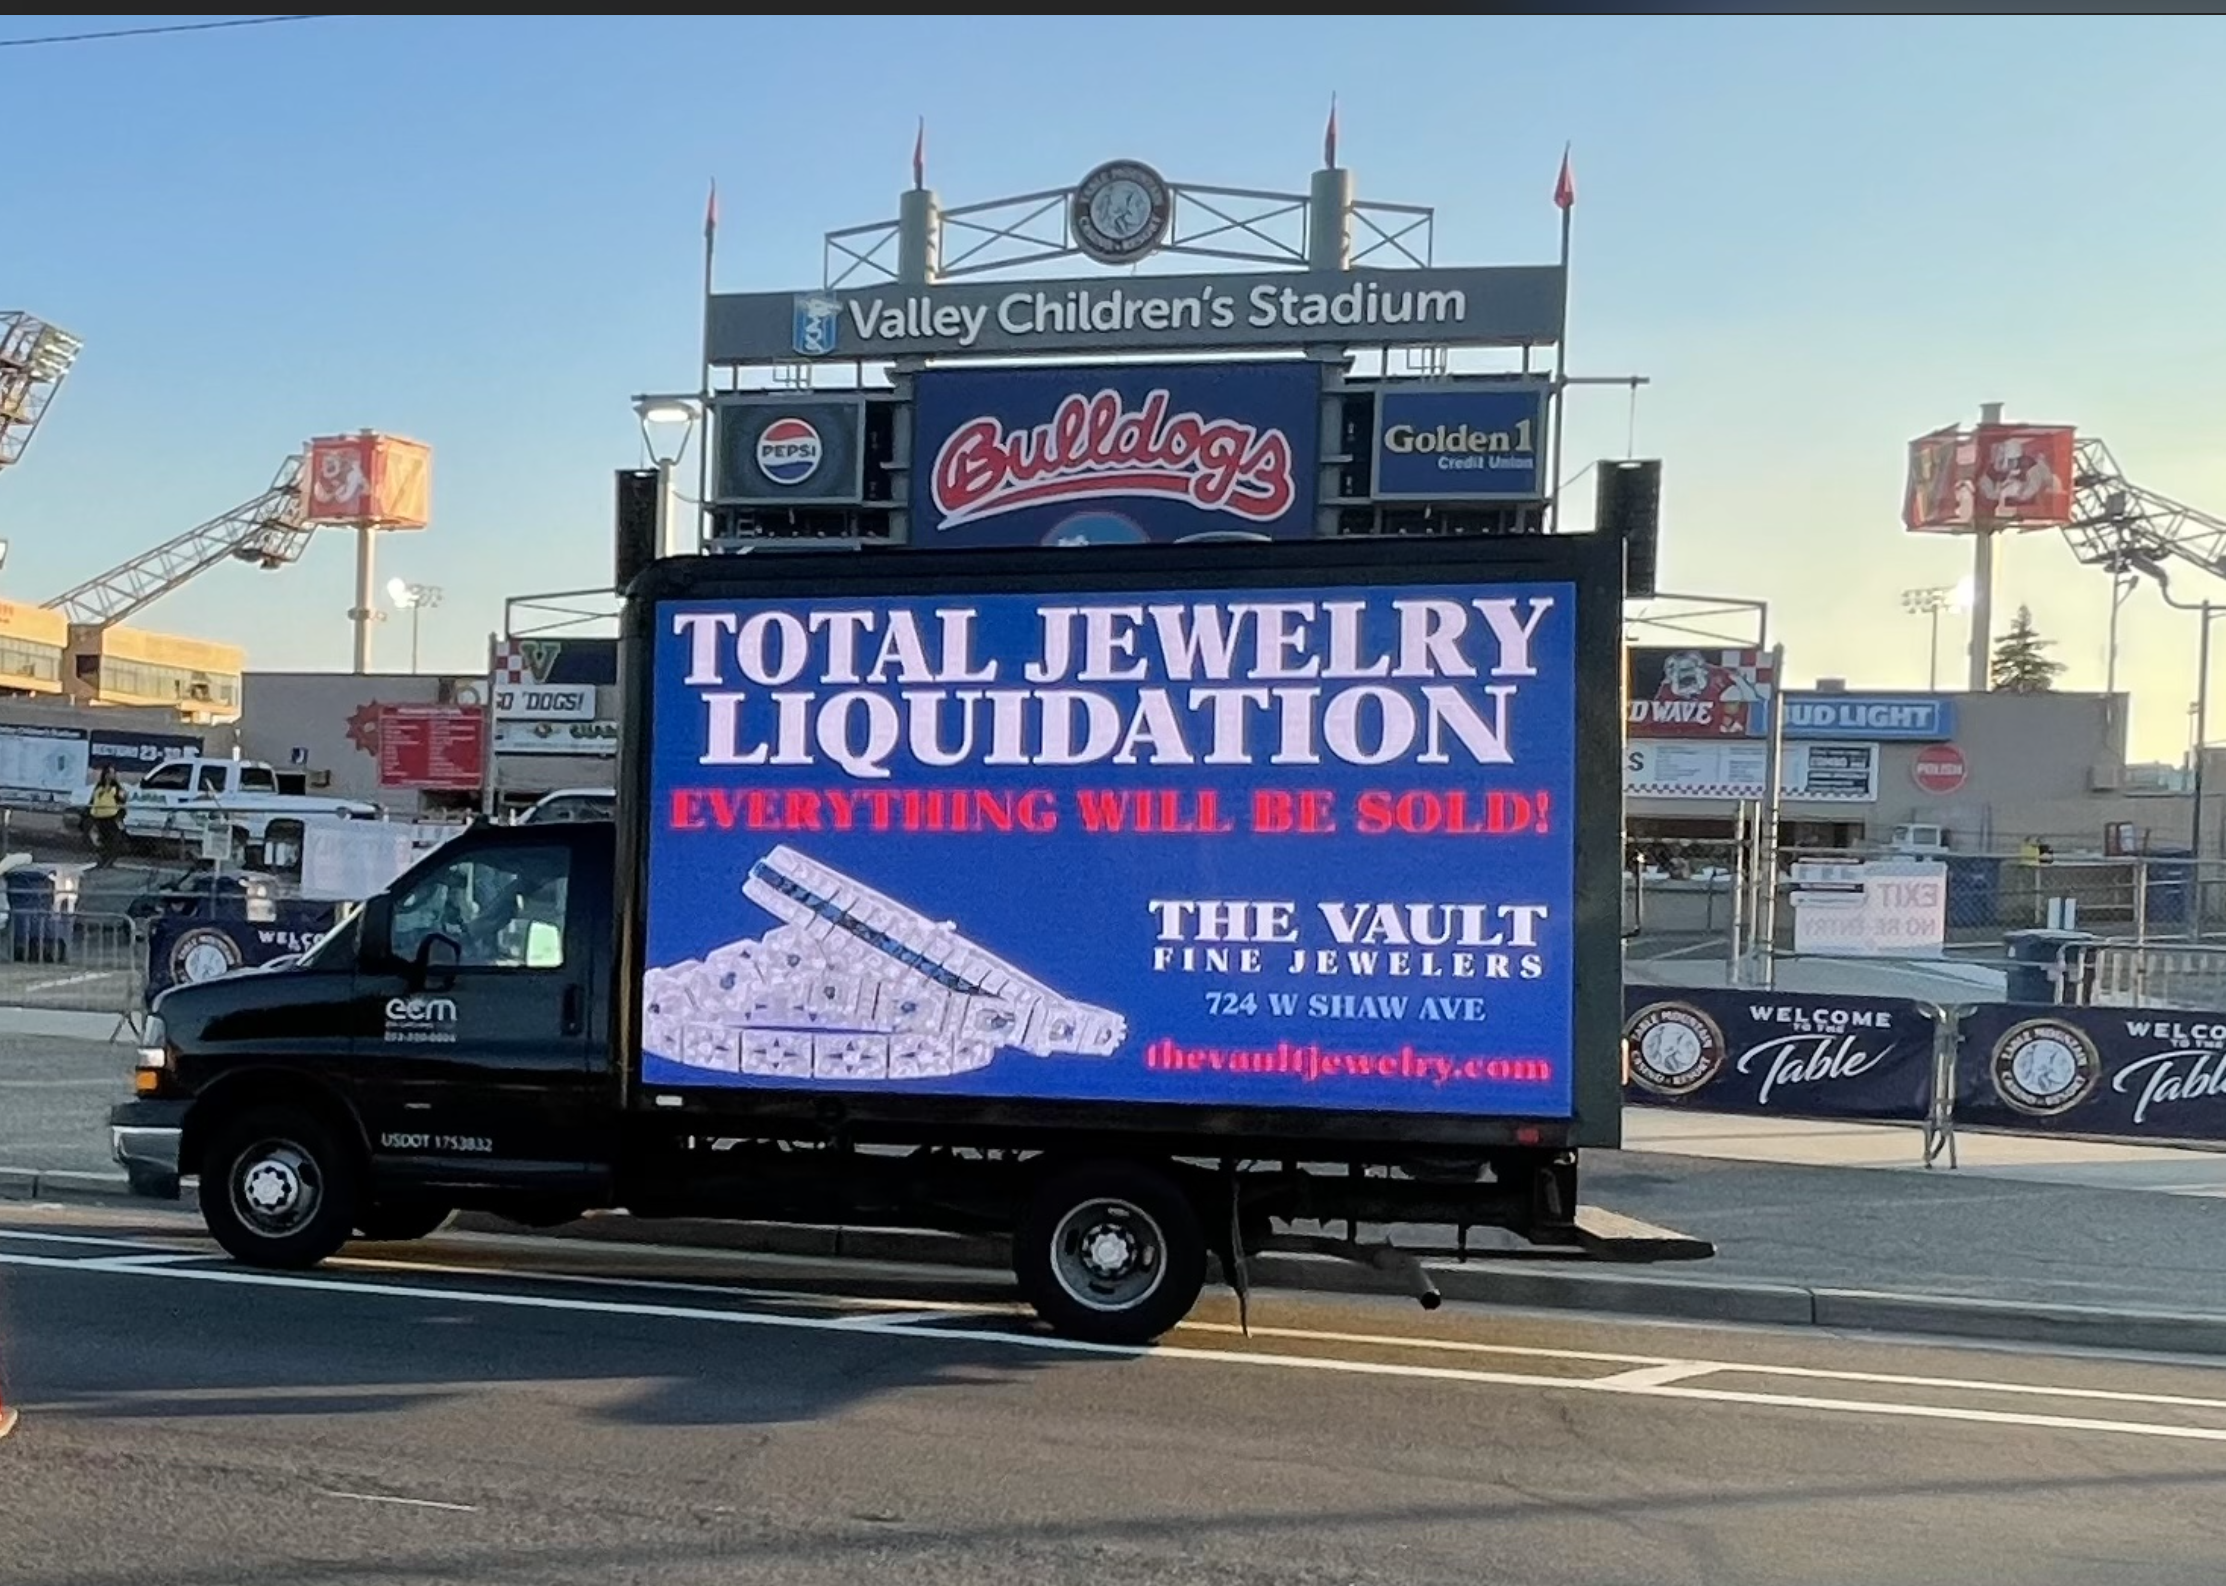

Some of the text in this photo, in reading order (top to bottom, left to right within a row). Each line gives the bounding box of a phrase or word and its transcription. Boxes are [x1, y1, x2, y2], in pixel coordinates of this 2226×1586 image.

[849, 282, 1467, 346] Valley Children's Stadium
[762, 444, 816, 458] PEPSI
[1384, 418, 1535, 454] Golden 1
[931, 388, 1295, 530] Bulldogs
[1438, 456, 1534, 470] Credit Union
[673, 597, 1555, 686] TOTAL JEWELRY
[522, 691, 585, 711] 'DOGS!
[1652, 701, 1714, 725] WAVE
[1784, 704, 1933, 729] UD LIGHT
[699, 683, 1516, 780] LIQUIDATION
[669, 786, 1551, 835] EVERYTHING WILL BE SOLD!
[1149, 900, 1549, 947] THE VAULT
[1153, 947, 1544, 980] FINE JEWELERS
[385, 998, 458, 1021] ecm
[1205, 991, 1487, 1022] 724 W SHAW AVE
[1749, 1006, 1892, 1028] WELCOME
[1146, 1040, 1551, 1085] thevaultjewelry.com
[1737, 1034, 1897, 1104] Table
[381, 1132, 430, 1147] USDOT
